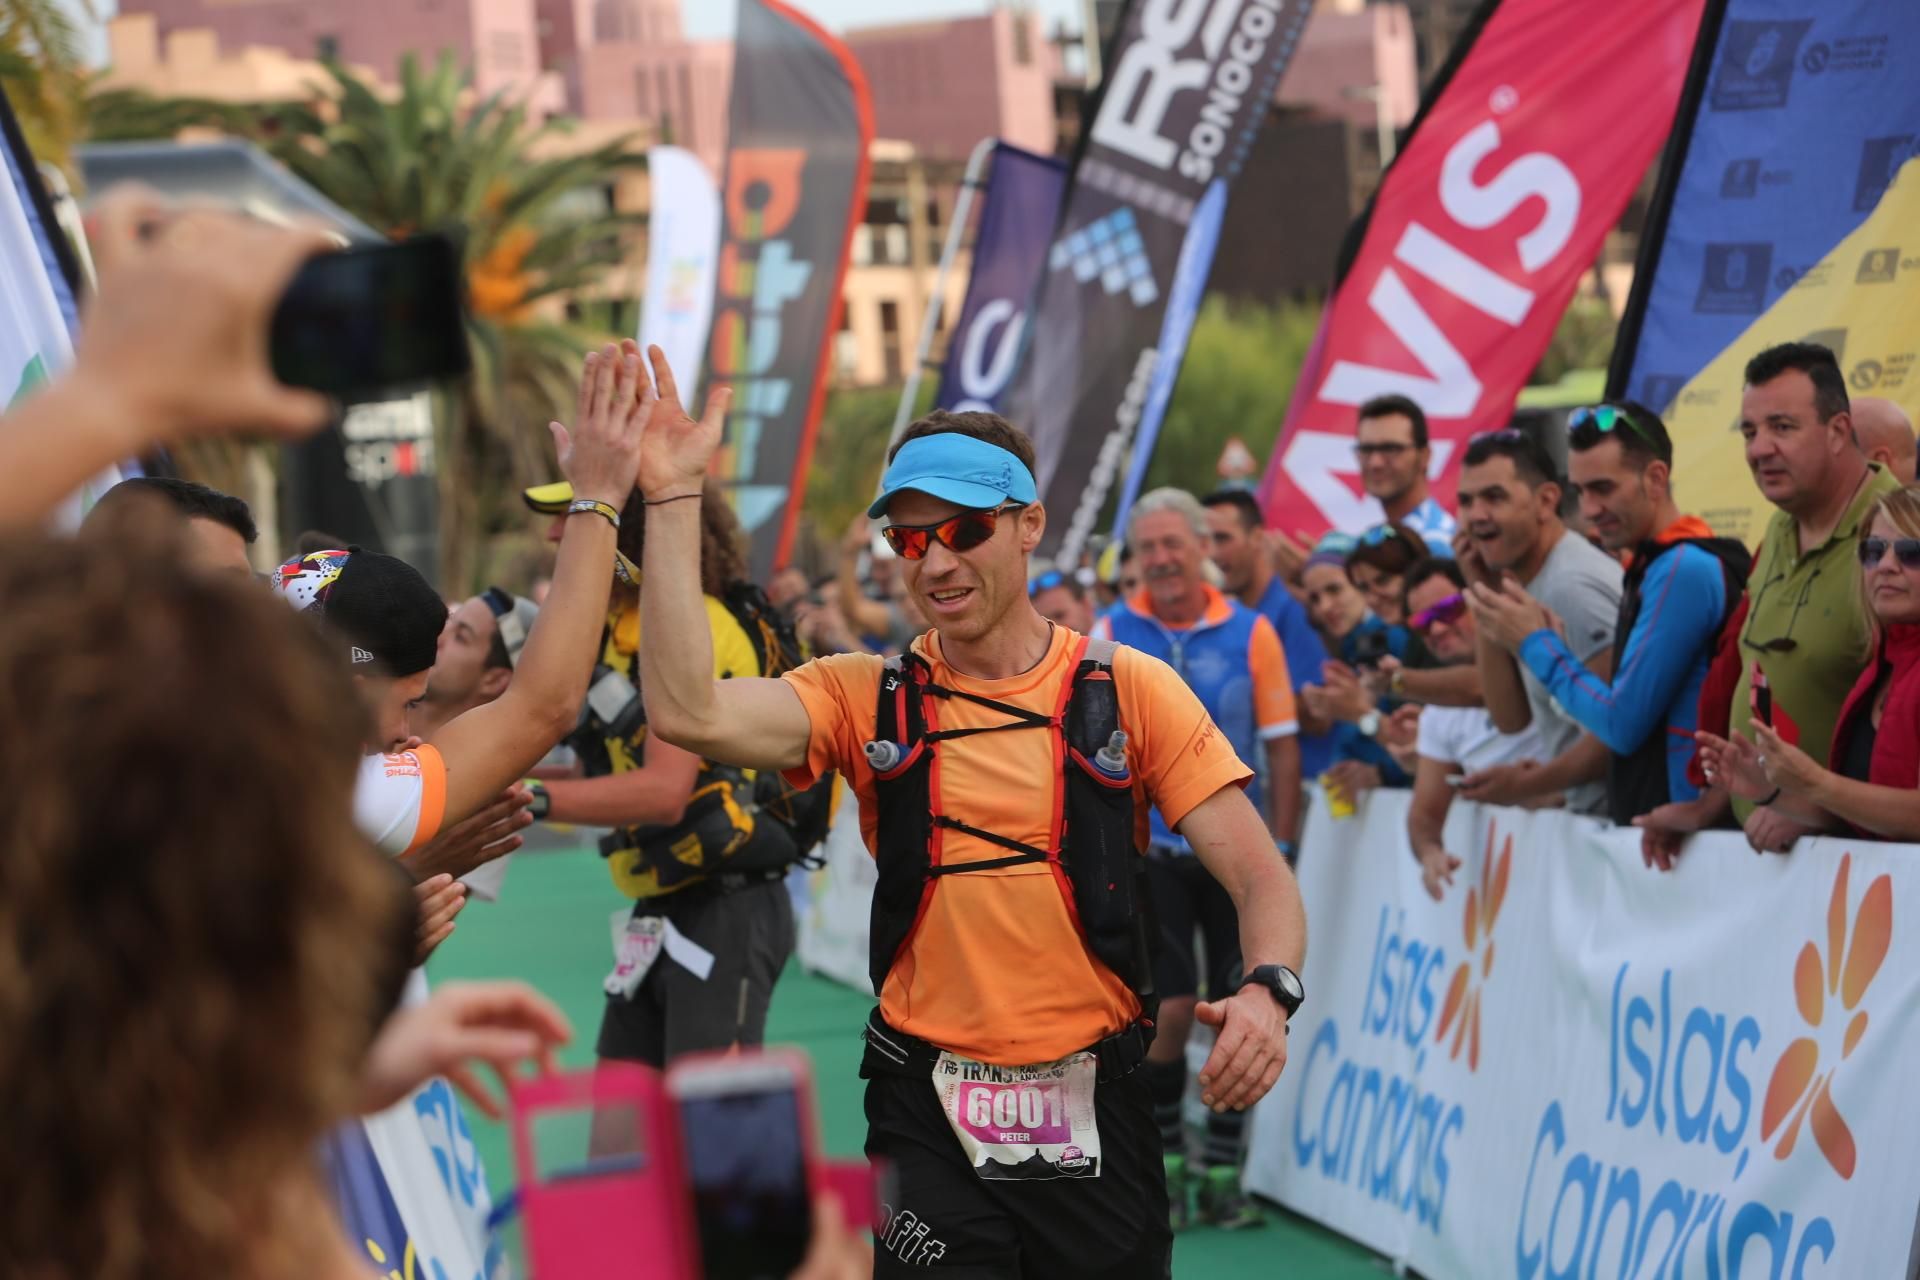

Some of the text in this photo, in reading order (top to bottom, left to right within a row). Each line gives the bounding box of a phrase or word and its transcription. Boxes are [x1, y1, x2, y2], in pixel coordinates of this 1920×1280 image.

[1606, 960, 1761, 1154] Islas
[966, 1087, 1063, 1129] 6001
[1000, 1132, 1031, 1142] PETER
[881, 1203, 947, 1266] fit
